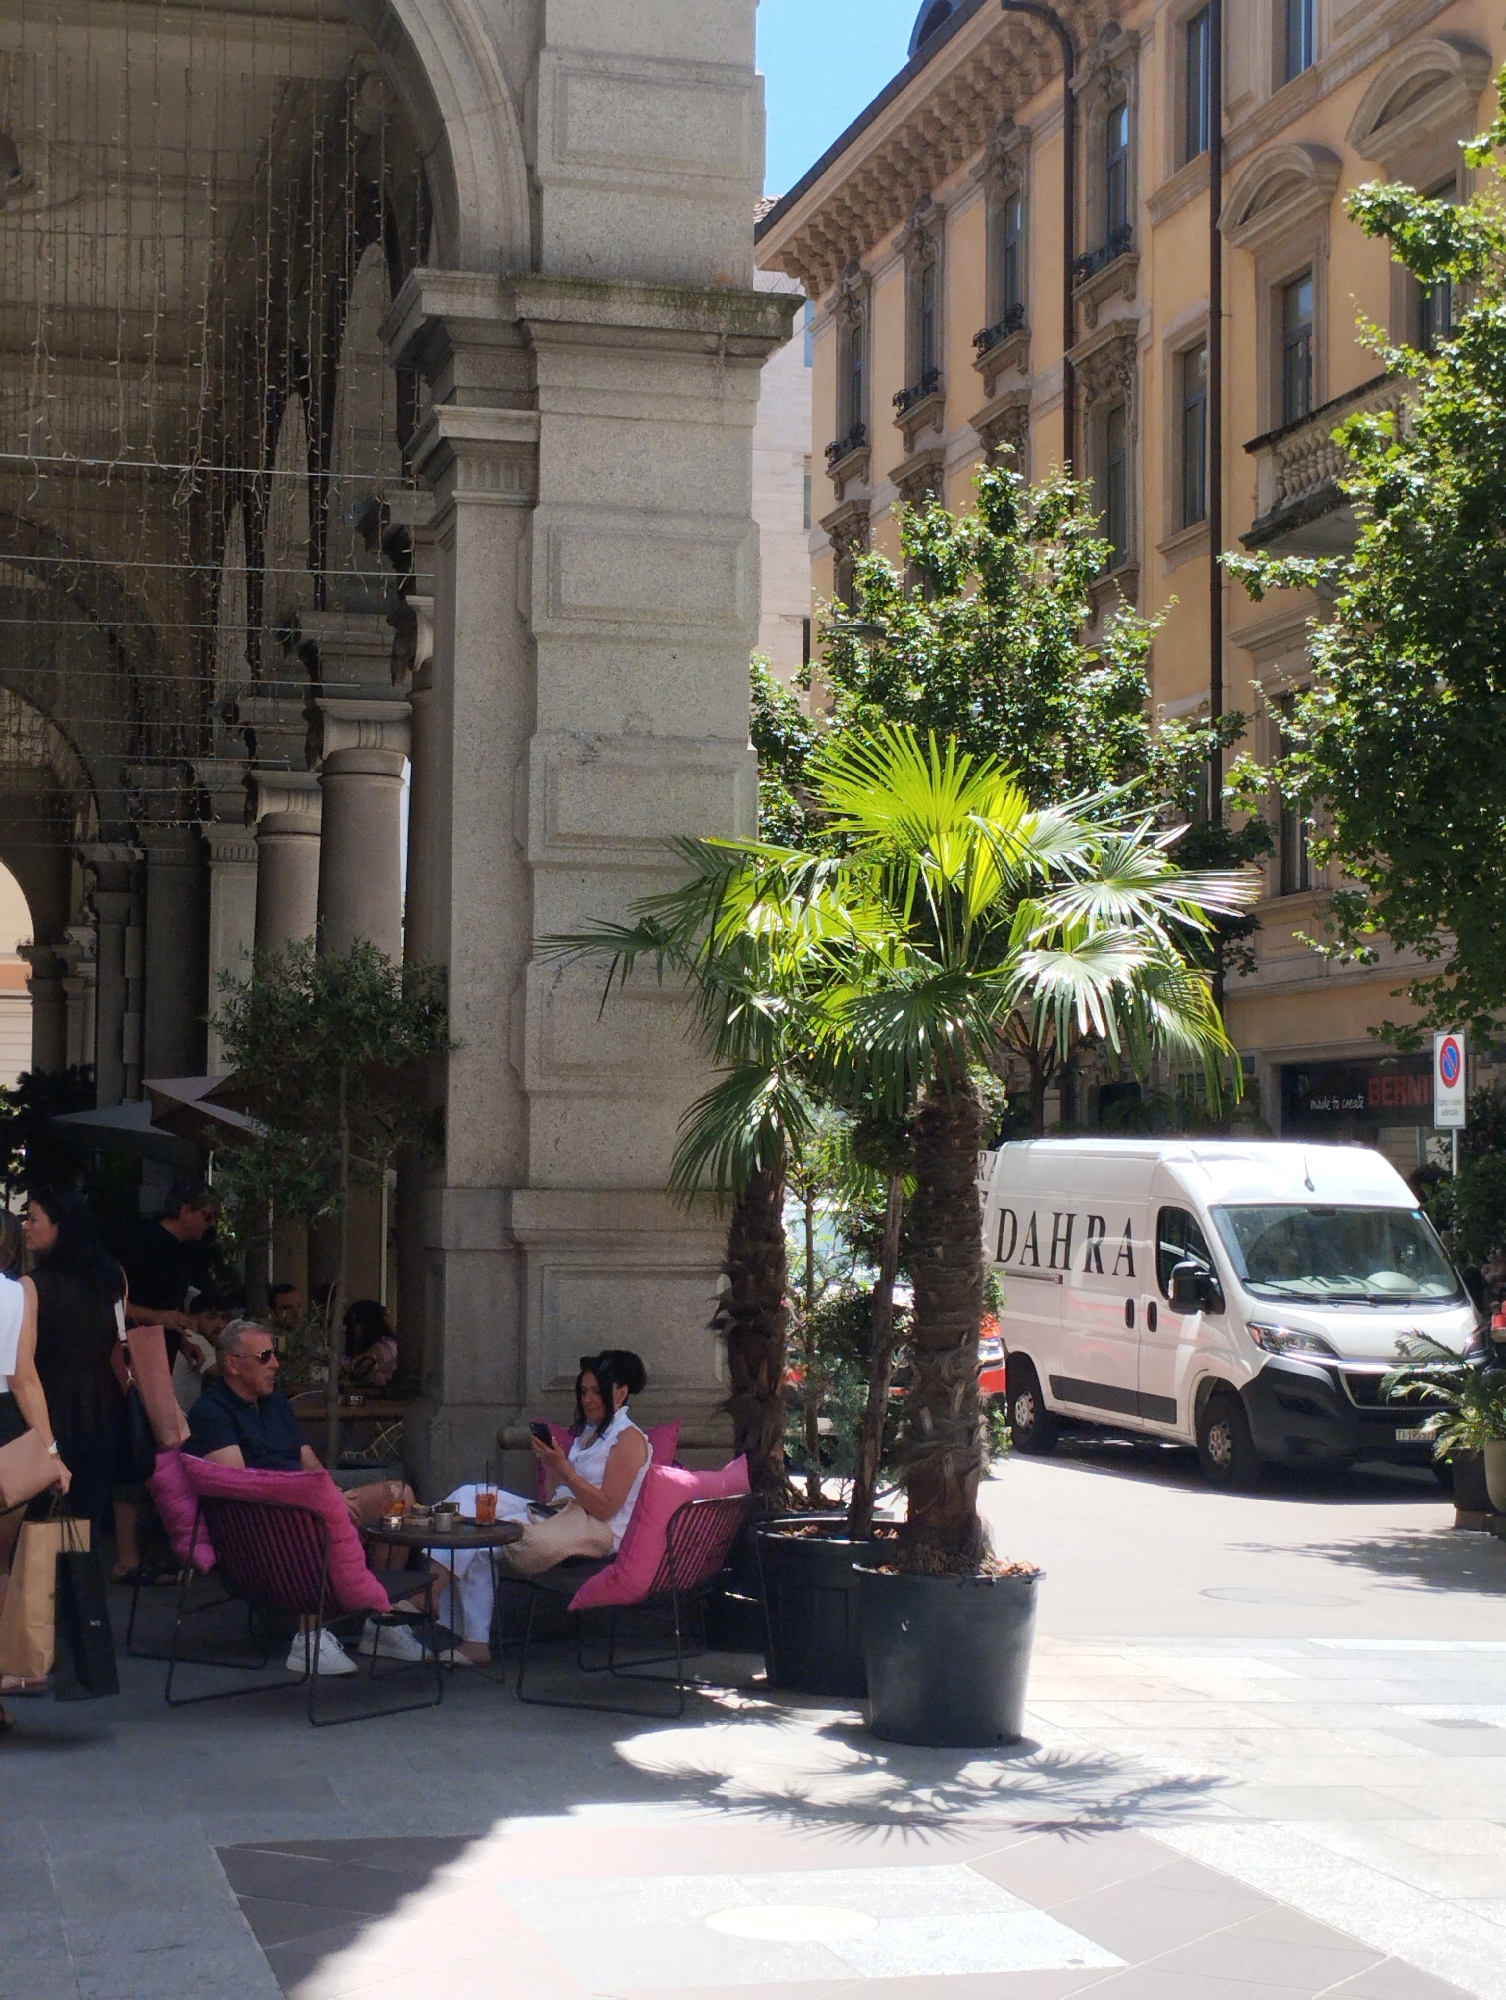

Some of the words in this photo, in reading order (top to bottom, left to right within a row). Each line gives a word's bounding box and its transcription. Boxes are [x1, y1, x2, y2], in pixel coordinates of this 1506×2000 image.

[1310, 1095, 1331, 1111] made
[1332, 1095, 1340, 1110] to
[1342, 1093, 1364, 1109] create
[1369, 1073, 1434, 1107] BERNI
[994, 1208, 1136, 1277] DAHRA
